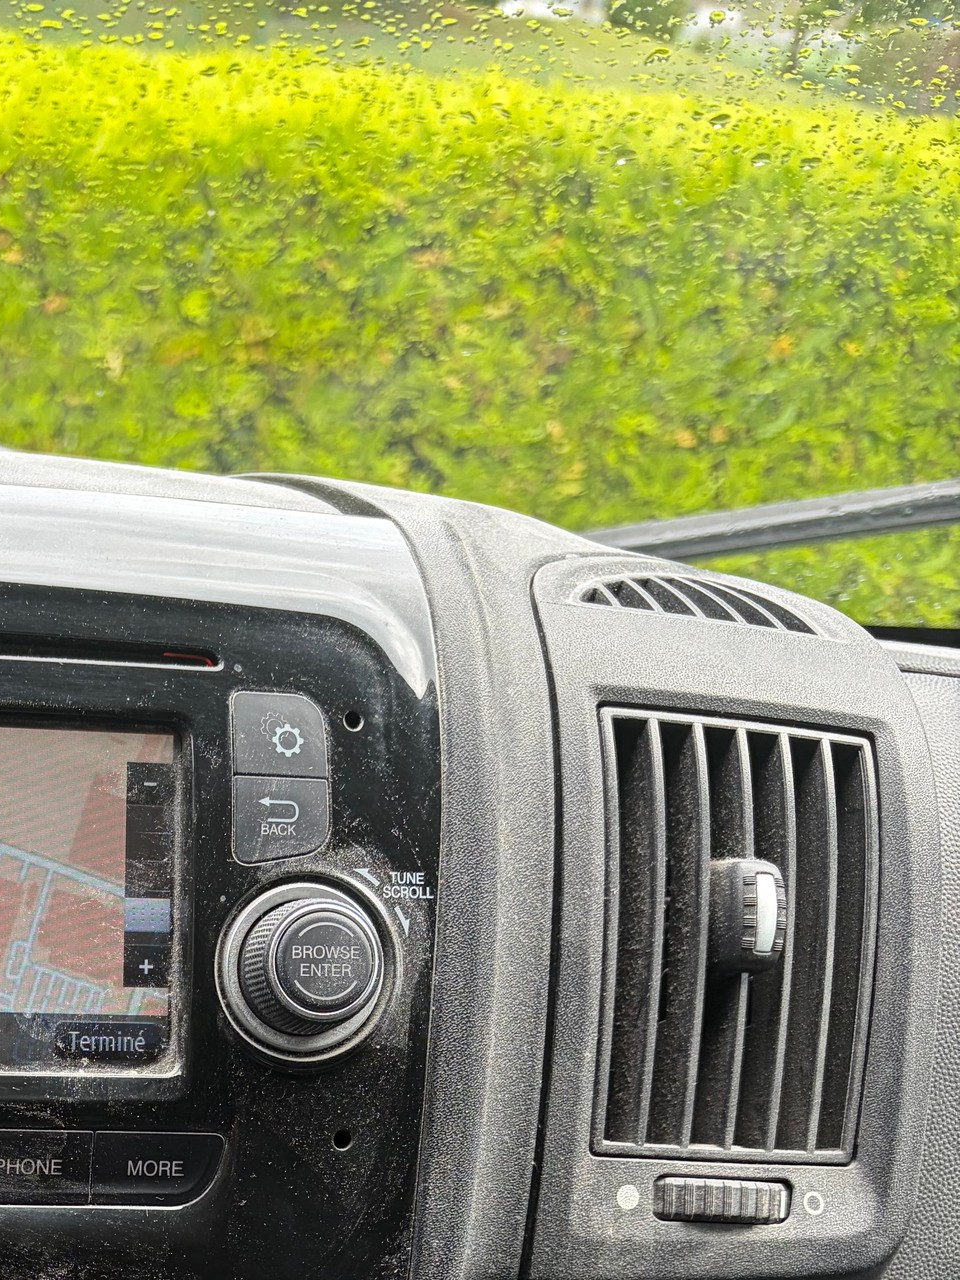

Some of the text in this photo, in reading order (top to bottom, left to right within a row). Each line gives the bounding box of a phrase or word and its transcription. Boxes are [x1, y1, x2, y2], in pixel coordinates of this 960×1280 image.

[260, 824, 297, 836] BACK
[389, 871, 425, 885] TUNE
[382, 886, 435, 899] SCROLL
[291, 945, 361, 959] BROWSE
[300, 963, 352, 977] ENTER
[68, 1031, 146, 1052] Terminé
[127, 1160, 185, 1177] MORE
